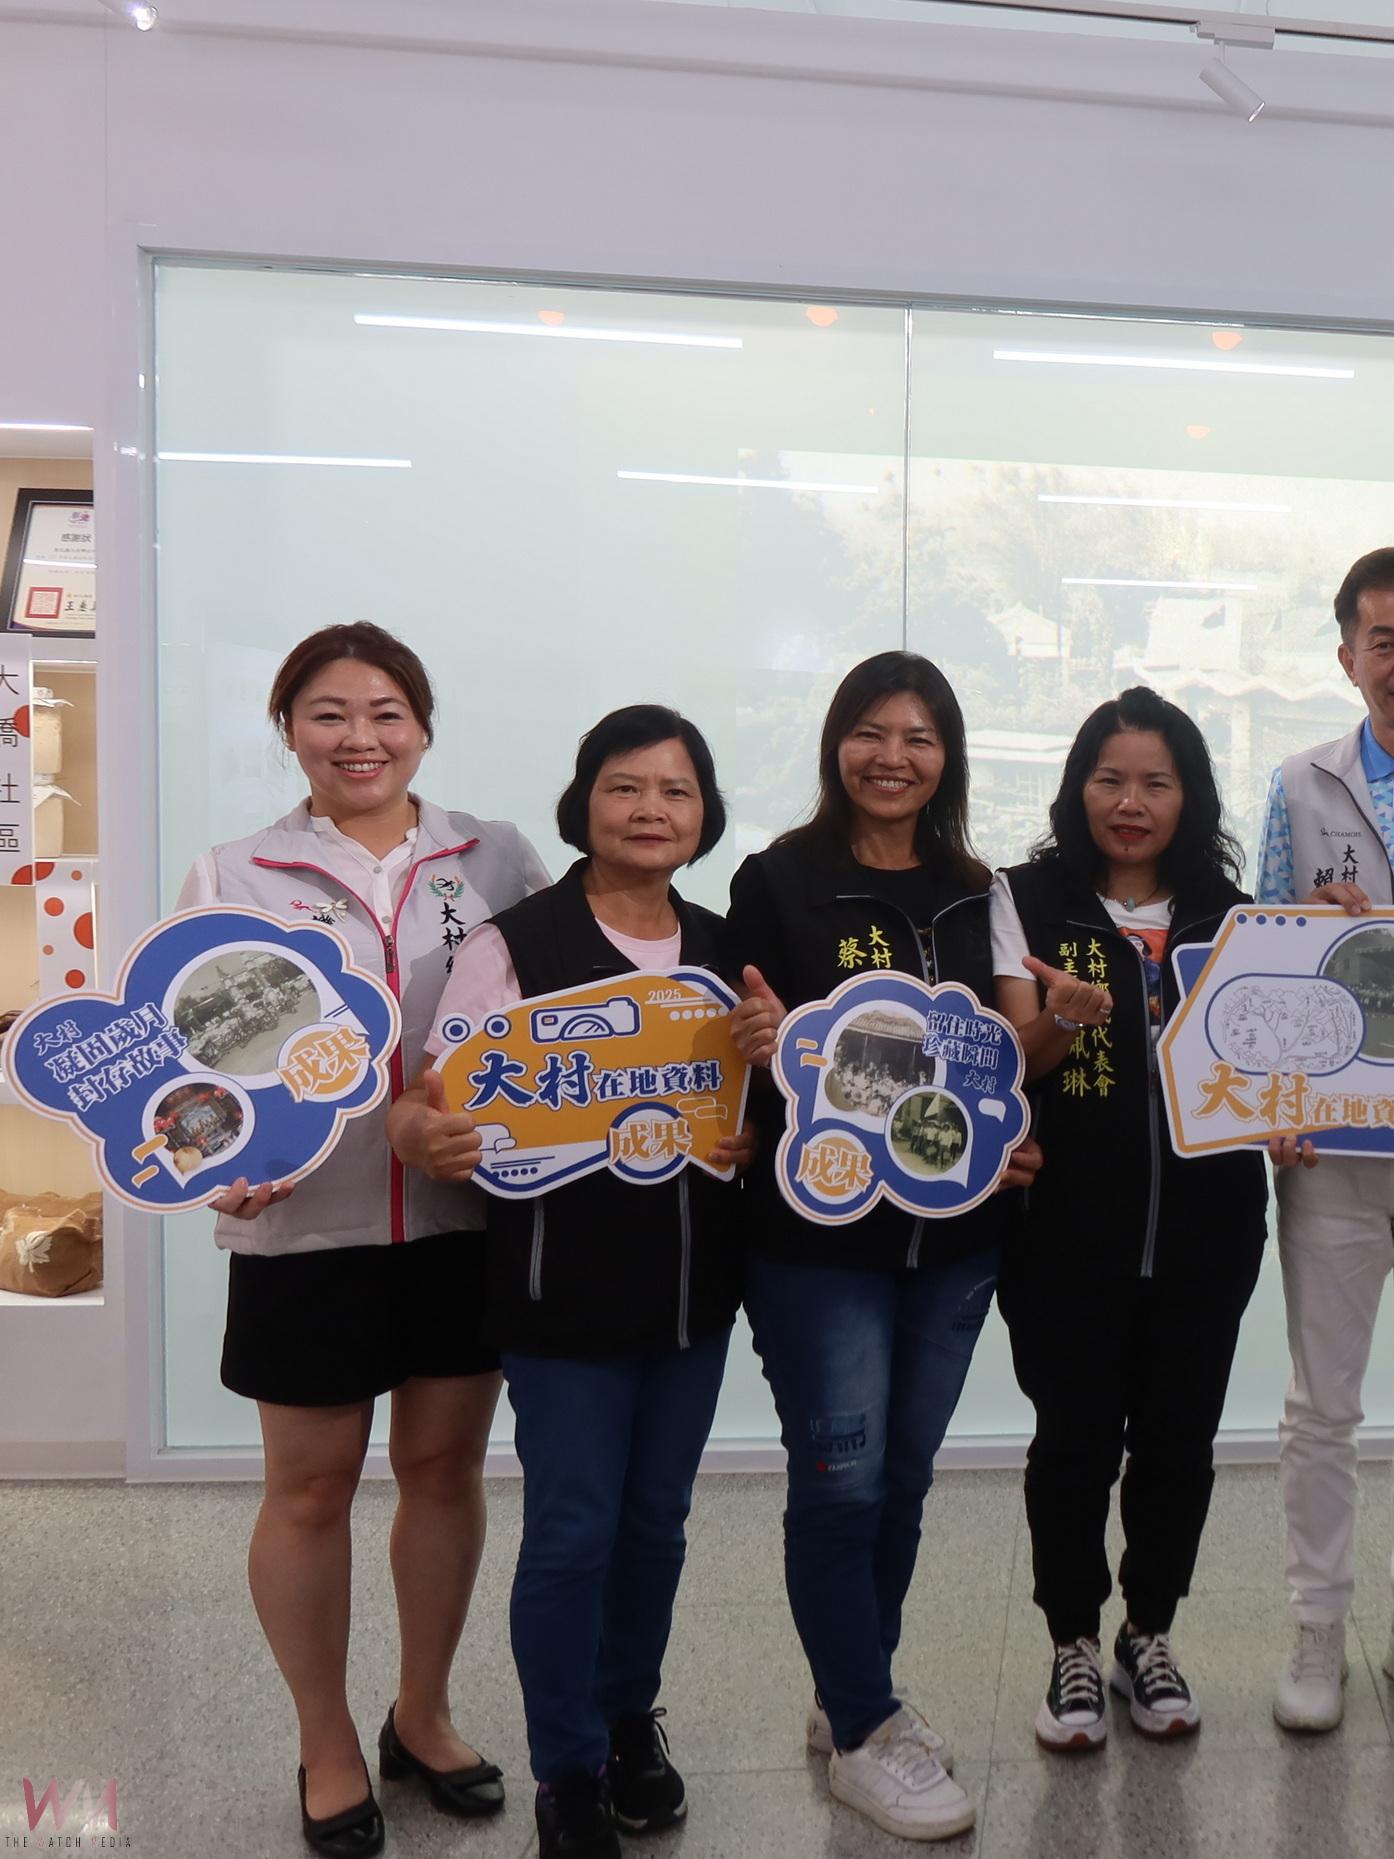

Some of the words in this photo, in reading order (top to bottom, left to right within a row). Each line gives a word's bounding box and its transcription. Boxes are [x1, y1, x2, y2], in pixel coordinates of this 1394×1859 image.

[63, 600, 96, 612] 王惠
[1341, 843, 1359, 884] 大村
[837, 937, 867, 969] 蔡
[868, 925, 893, 969] 大村
[648, 988, 682, 1001] 2025
[34, 1019, 82, 1056] 大村
[926, 1009, 1002, 1046] 留住時光
[1086, 937, 1116, 1097] 大村代表會
[44, 1002, 168, 1083] 凝固歲月
[922, 1032, 1000, 1070] 珍藏瞬間
[276, 1026, 373, 1103] 成果
[463, 1048, 722, 1111] 大村在地資料
[962, 1069, 997, 1095] 大村
[607, 1116, 693, 1166] 成果
[794, 1142, 874, 1194] 成果
